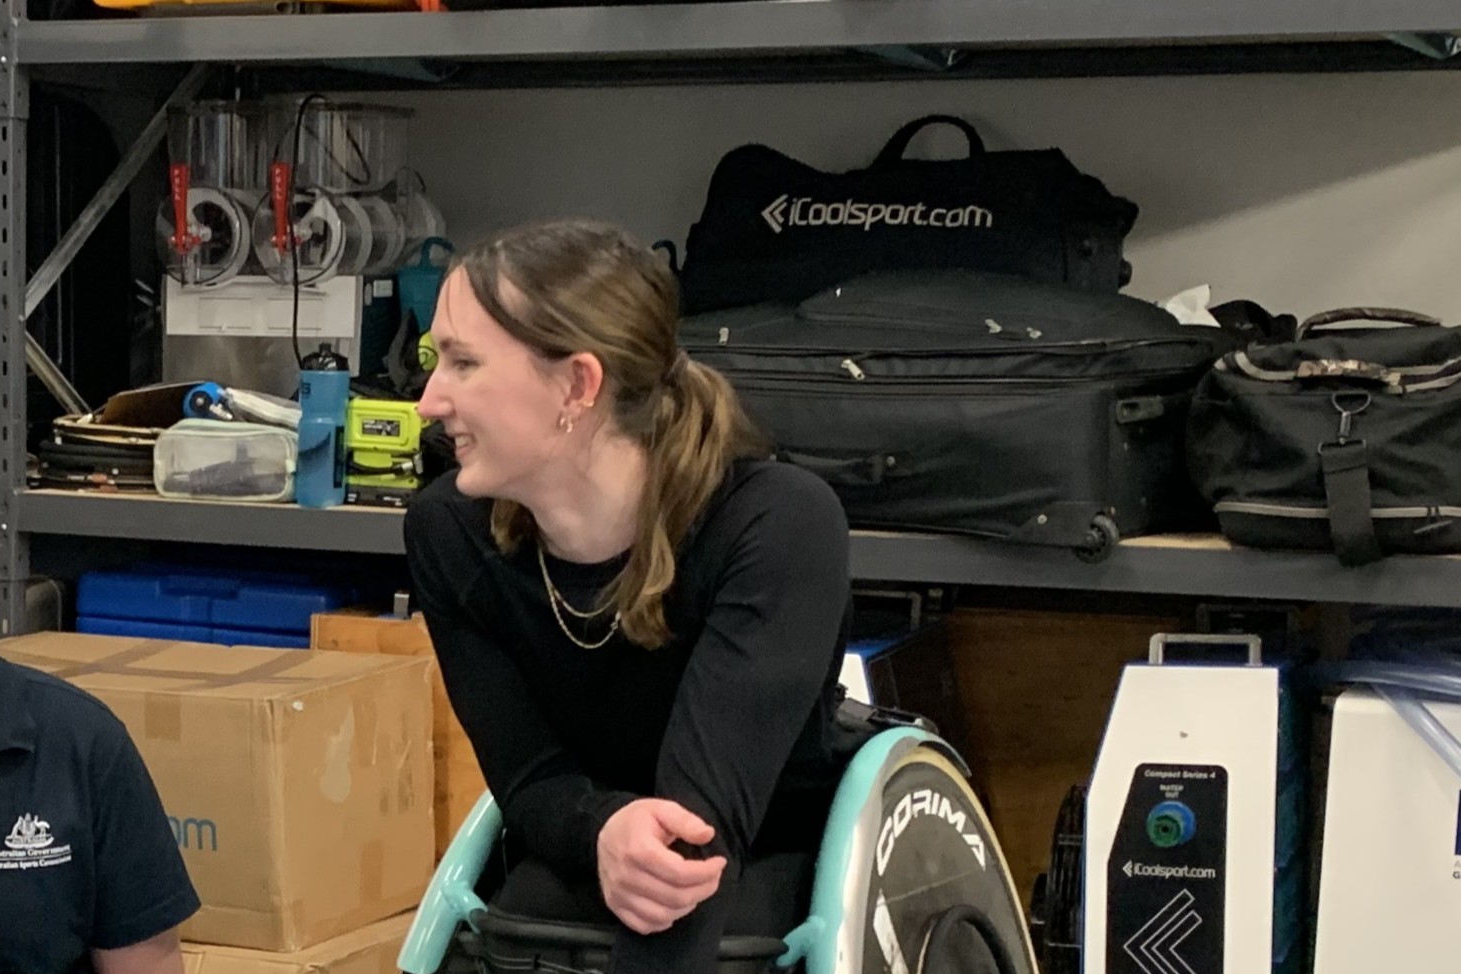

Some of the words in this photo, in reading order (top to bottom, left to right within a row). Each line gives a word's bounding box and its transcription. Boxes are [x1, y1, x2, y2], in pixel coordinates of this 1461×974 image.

[789, 198, 993, 231] iCoolsport.com
[1144, 769, 1181, 779] Compact
[1182, 771, 1208, 779] Series
[1133, 862, 1216, 879] iCoolsport.com
